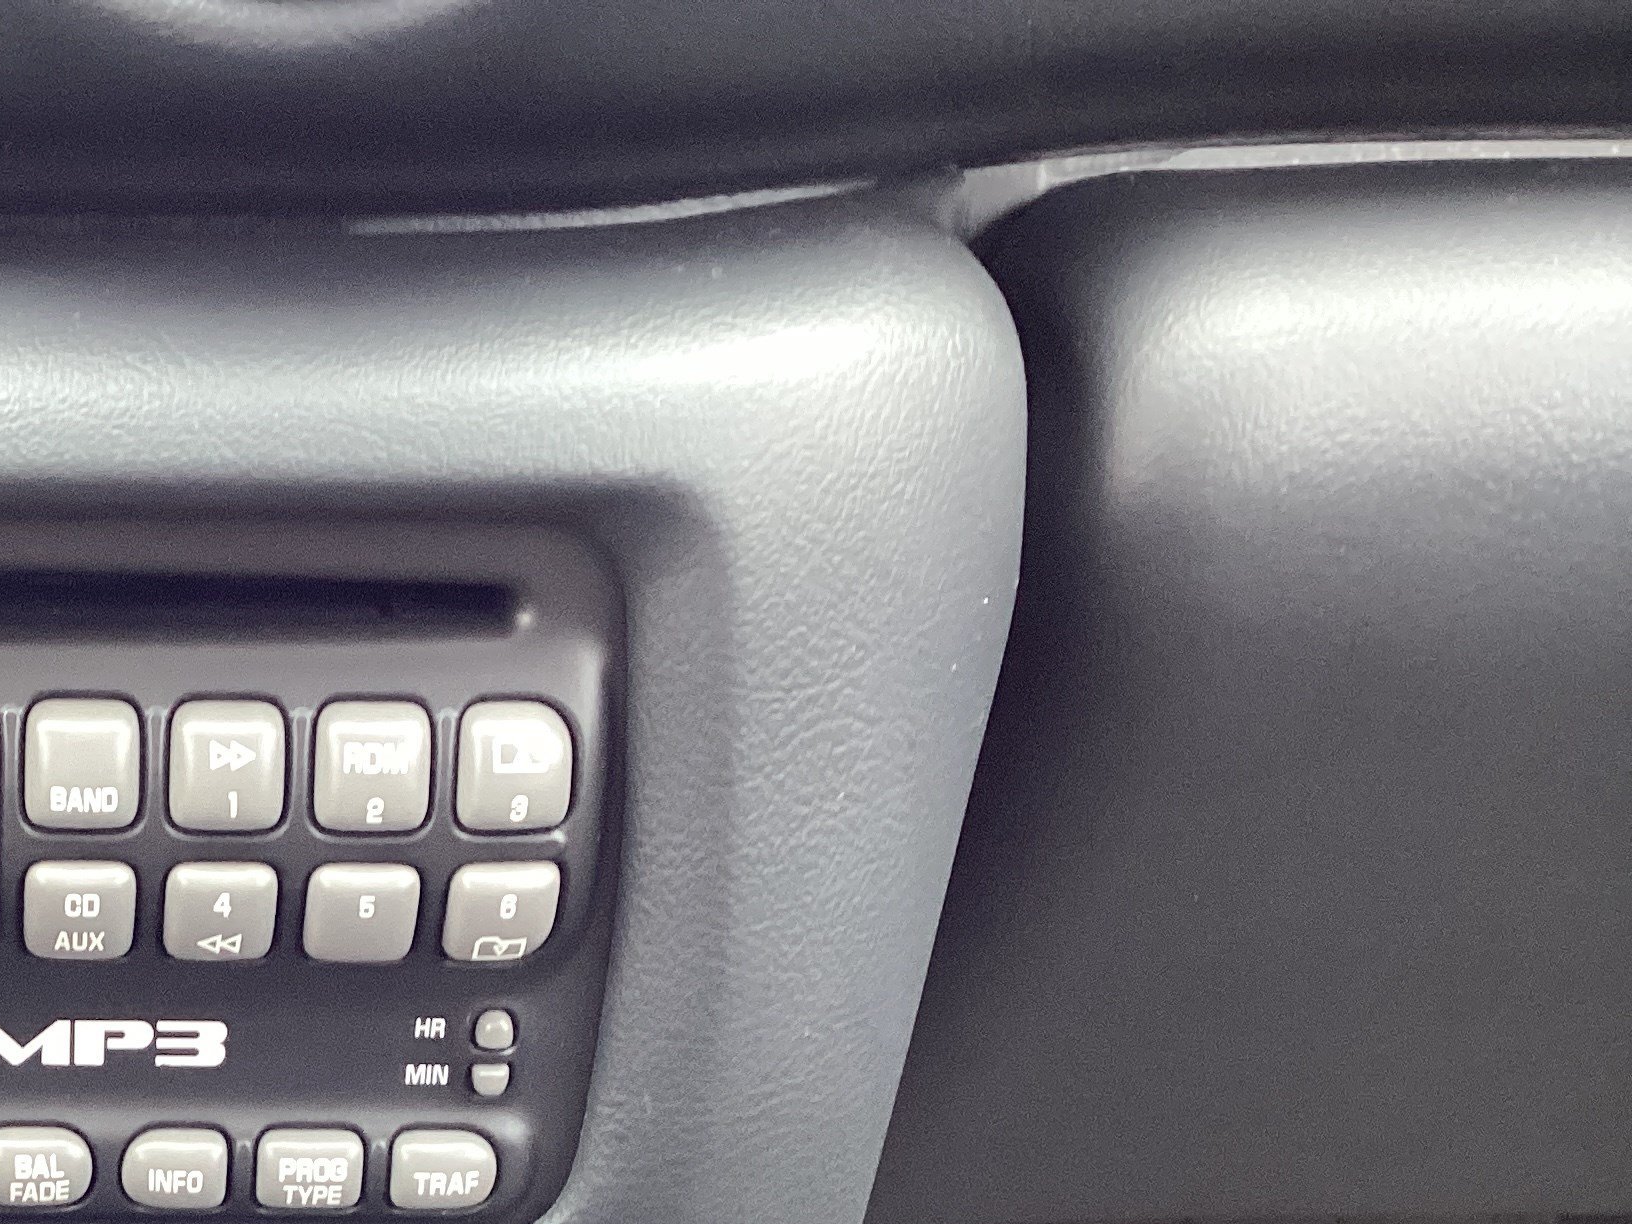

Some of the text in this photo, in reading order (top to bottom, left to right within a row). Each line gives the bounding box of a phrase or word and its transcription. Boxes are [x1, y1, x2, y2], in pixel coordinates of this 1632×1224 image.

[49, 786, 119, 815] BAND
[227, 791, 239, 819] 1
[365, 797, 385, 824] 2
[509, 796, 529, 823] 3
[64, 893, 101, 918] CD
[213, 893, 233, 919] 4
[358, 895, 376, 919] 5
[499, 894, 518, 919] 6
[53, 930, 105, 952] AUX
[414, 1017, 447, 1040] HR
[404, 1062, 450, 1087] MIN
[13, 1154, 66, 1180] BAL
[278, 1157, 349, 1183] PROG
[8, 1179, 71, 1203] FADE
[147, 1168, 204, 1194] INFO
[413, 1170, 480, 1196] TRAF
[282, 1184, 343, 1206] TYPE
